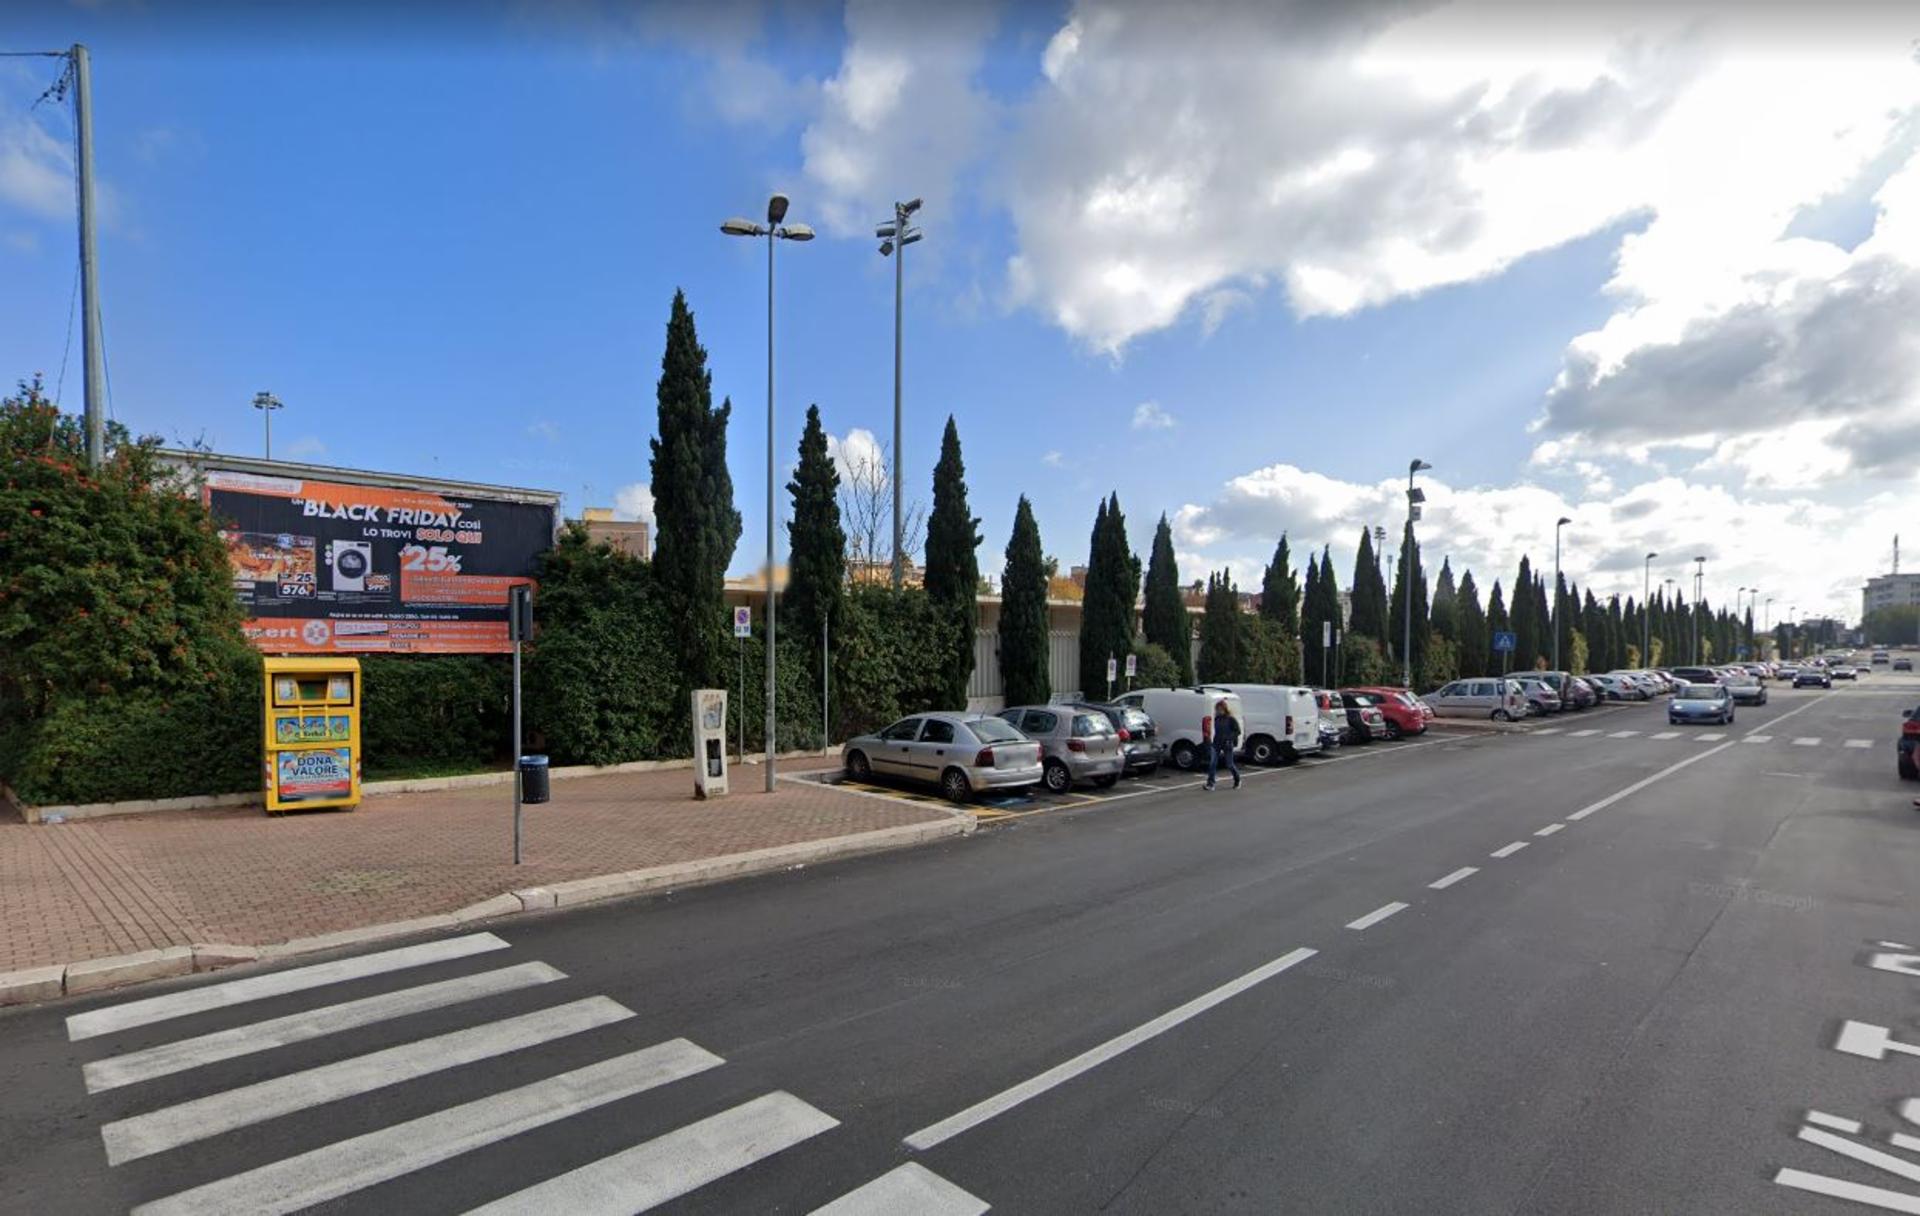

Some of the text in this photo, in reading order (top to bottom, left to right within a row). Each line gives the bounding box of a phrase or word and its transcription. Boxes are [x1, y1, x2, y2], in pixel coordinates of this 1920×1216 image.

[303, 498, 380, 523] BLACK
[387, 507, 463, 528] FRIDAY
[363, 527, 482, 544] LO TROVI SOLO QUI
[297, 756, 333, 766] DONA
[291, 765, 339, 776] VALORE
